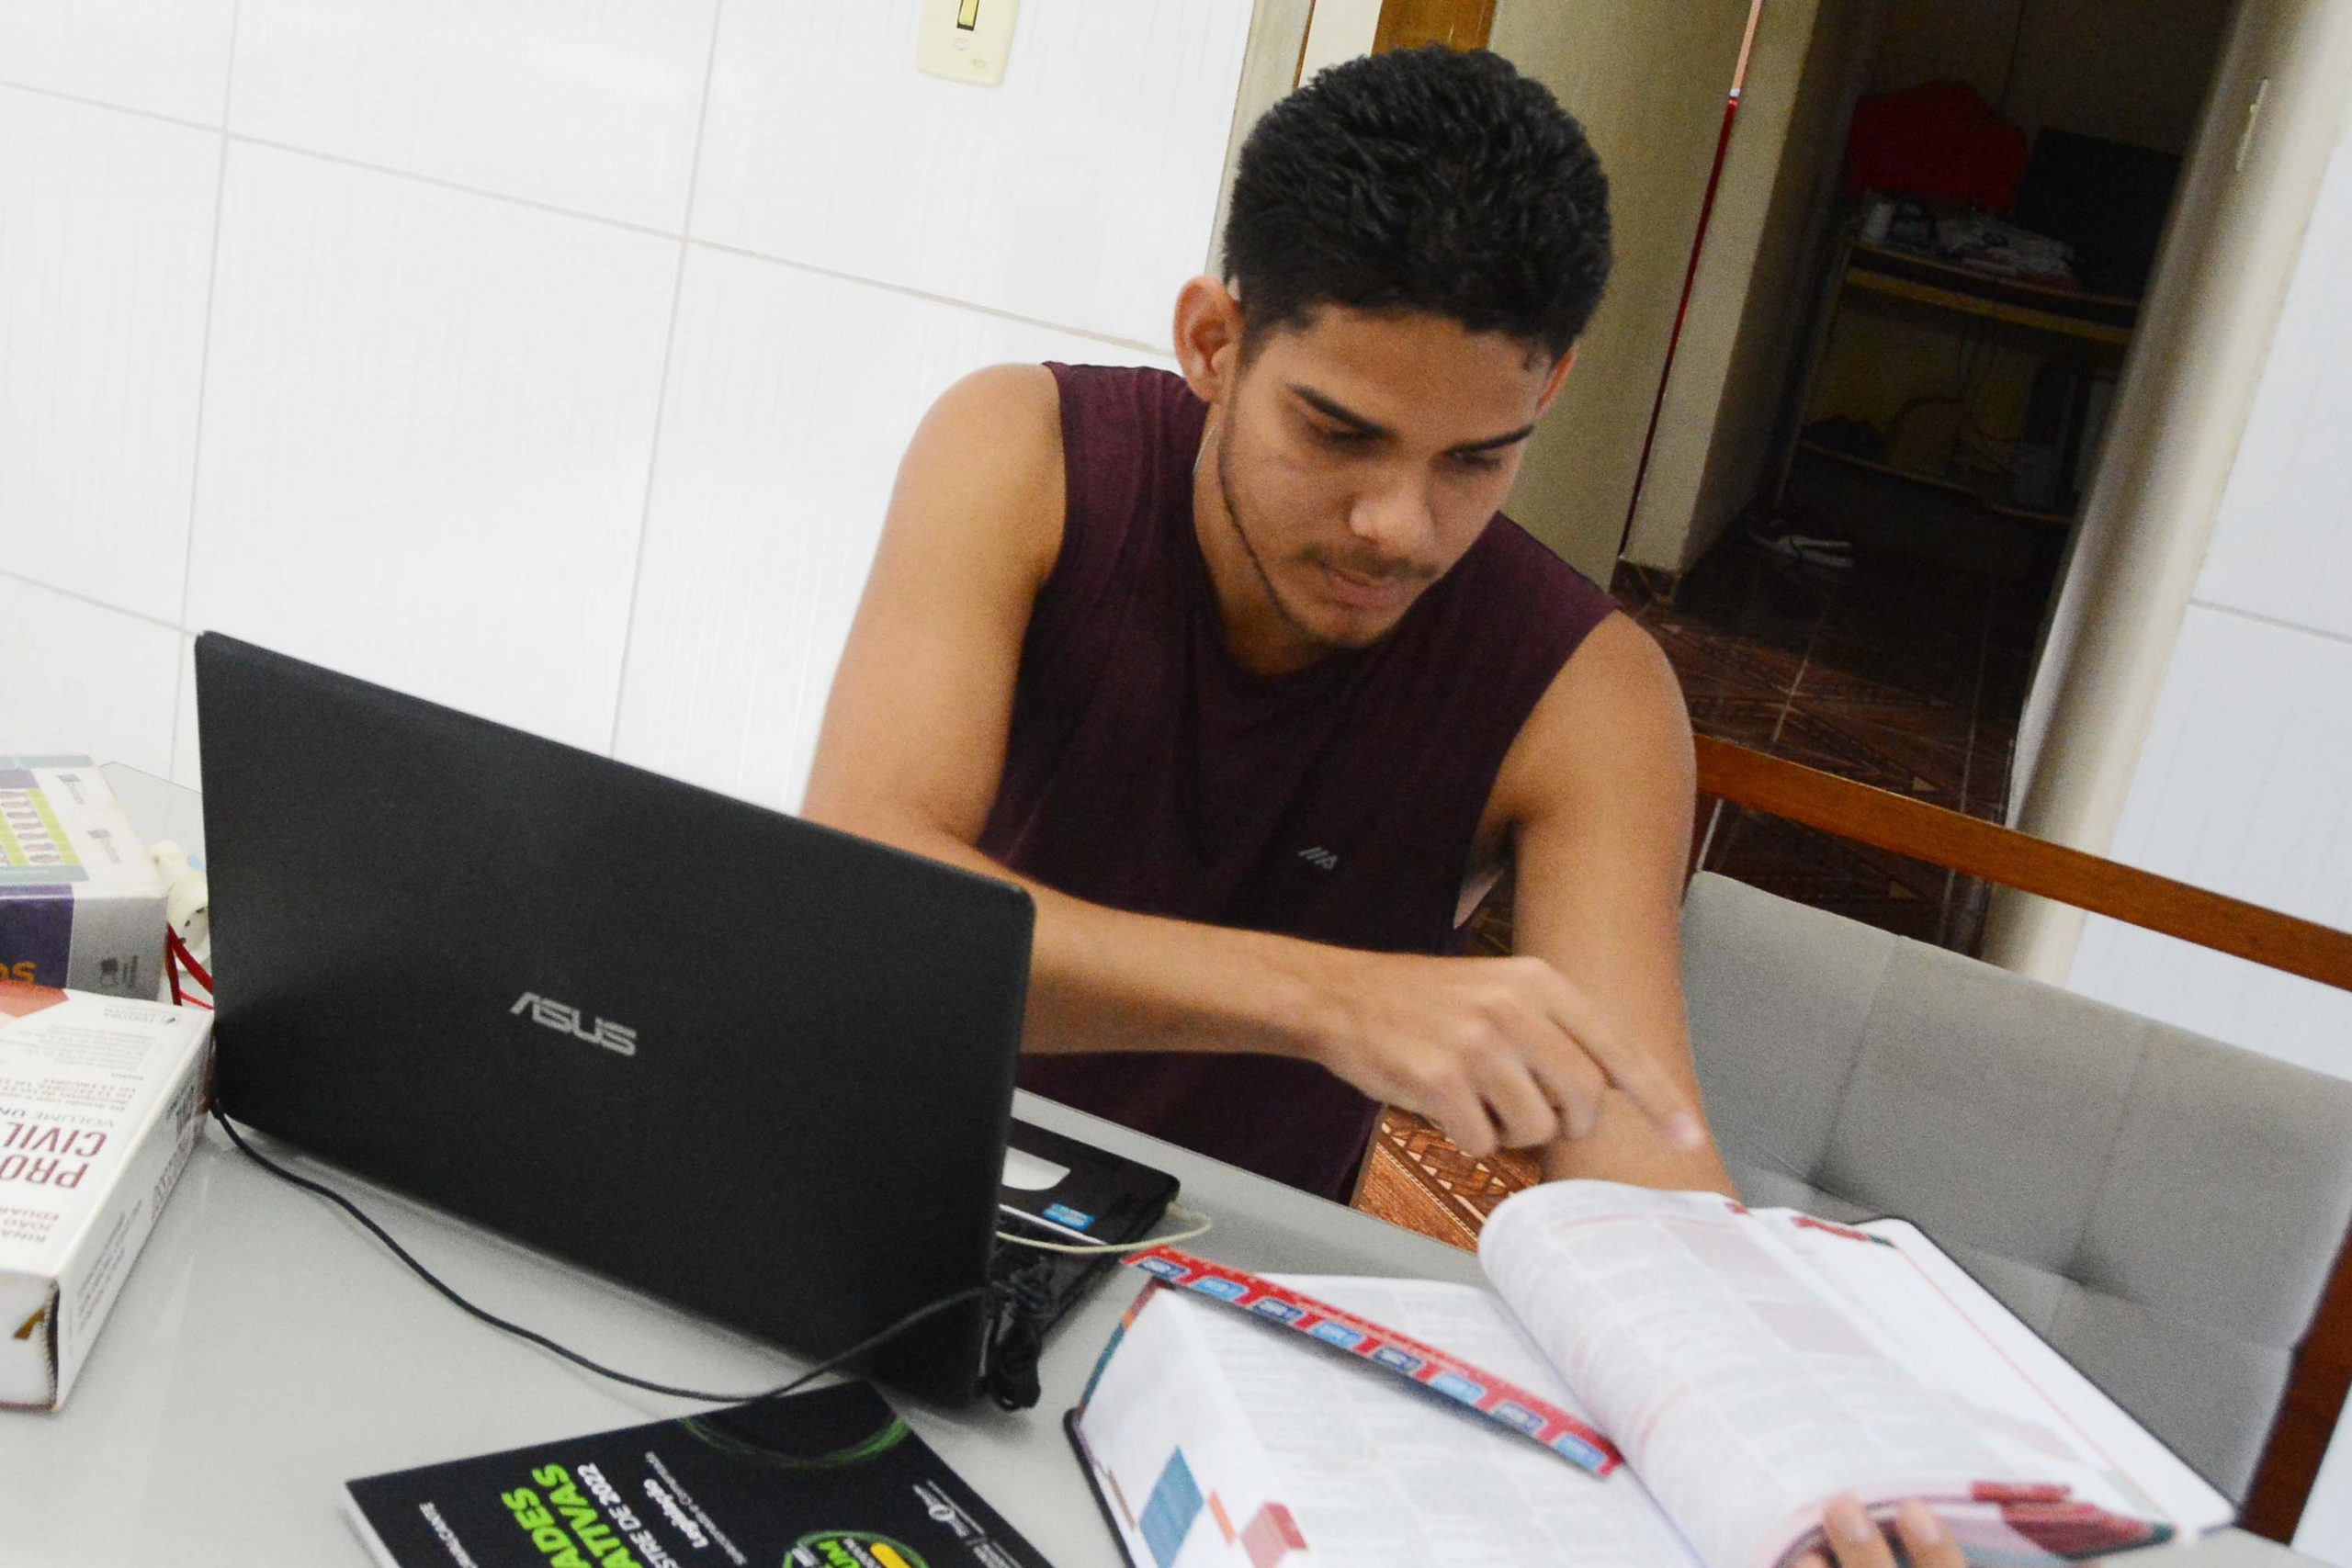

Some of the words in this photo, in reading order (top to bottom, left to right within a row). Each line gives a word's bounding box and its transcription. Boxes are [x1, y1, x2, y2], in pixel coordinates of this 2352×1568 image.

[510, 991, 637, 1055] ASUS
[3, 1121, 107, 1157] CIVIL
[0, 1154, 89, 1189] PRO
[577, 1462, 621, 1506] 2022
[501, 1487, 593, 1568] ADES
[531, 1462, 642, 1568] ATIVAS
[608, 1504, 641, 1532] DE
